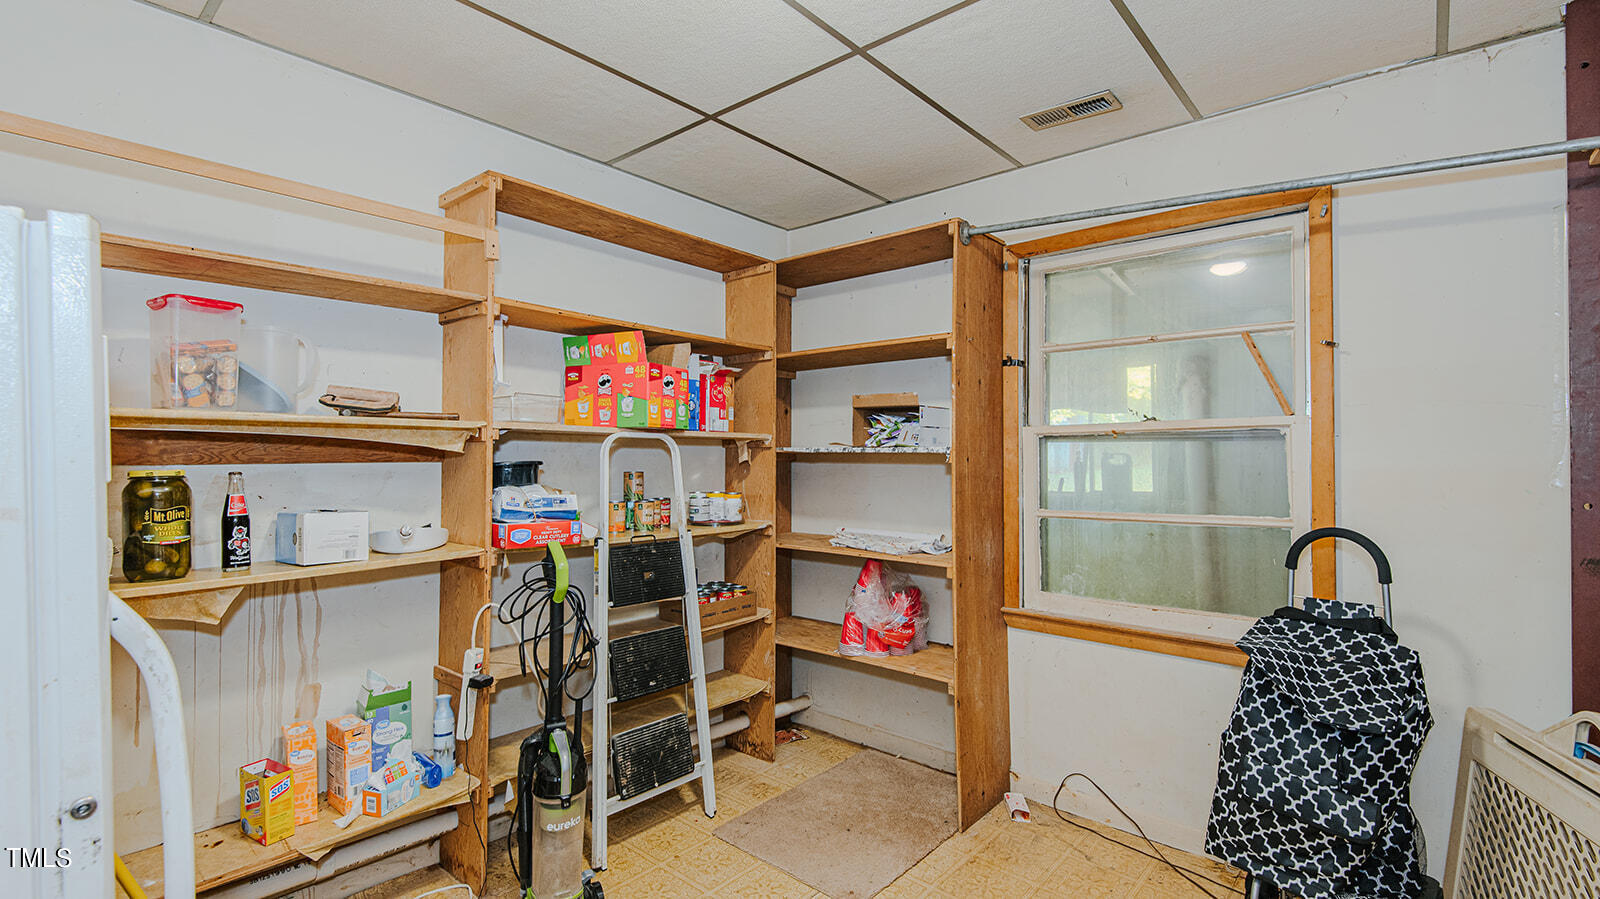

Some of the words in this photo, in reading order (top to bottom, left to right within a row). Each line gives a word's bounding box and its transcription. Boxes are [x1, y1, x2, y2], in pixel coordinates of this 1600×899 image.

[634, 365, 646, 374] 48
[166, 509, 185, 521] Olive
[246, 787, 260, 803] SOS
[270, 779, 290, 798] SOS
[547, 816, 581, 831] eureka
